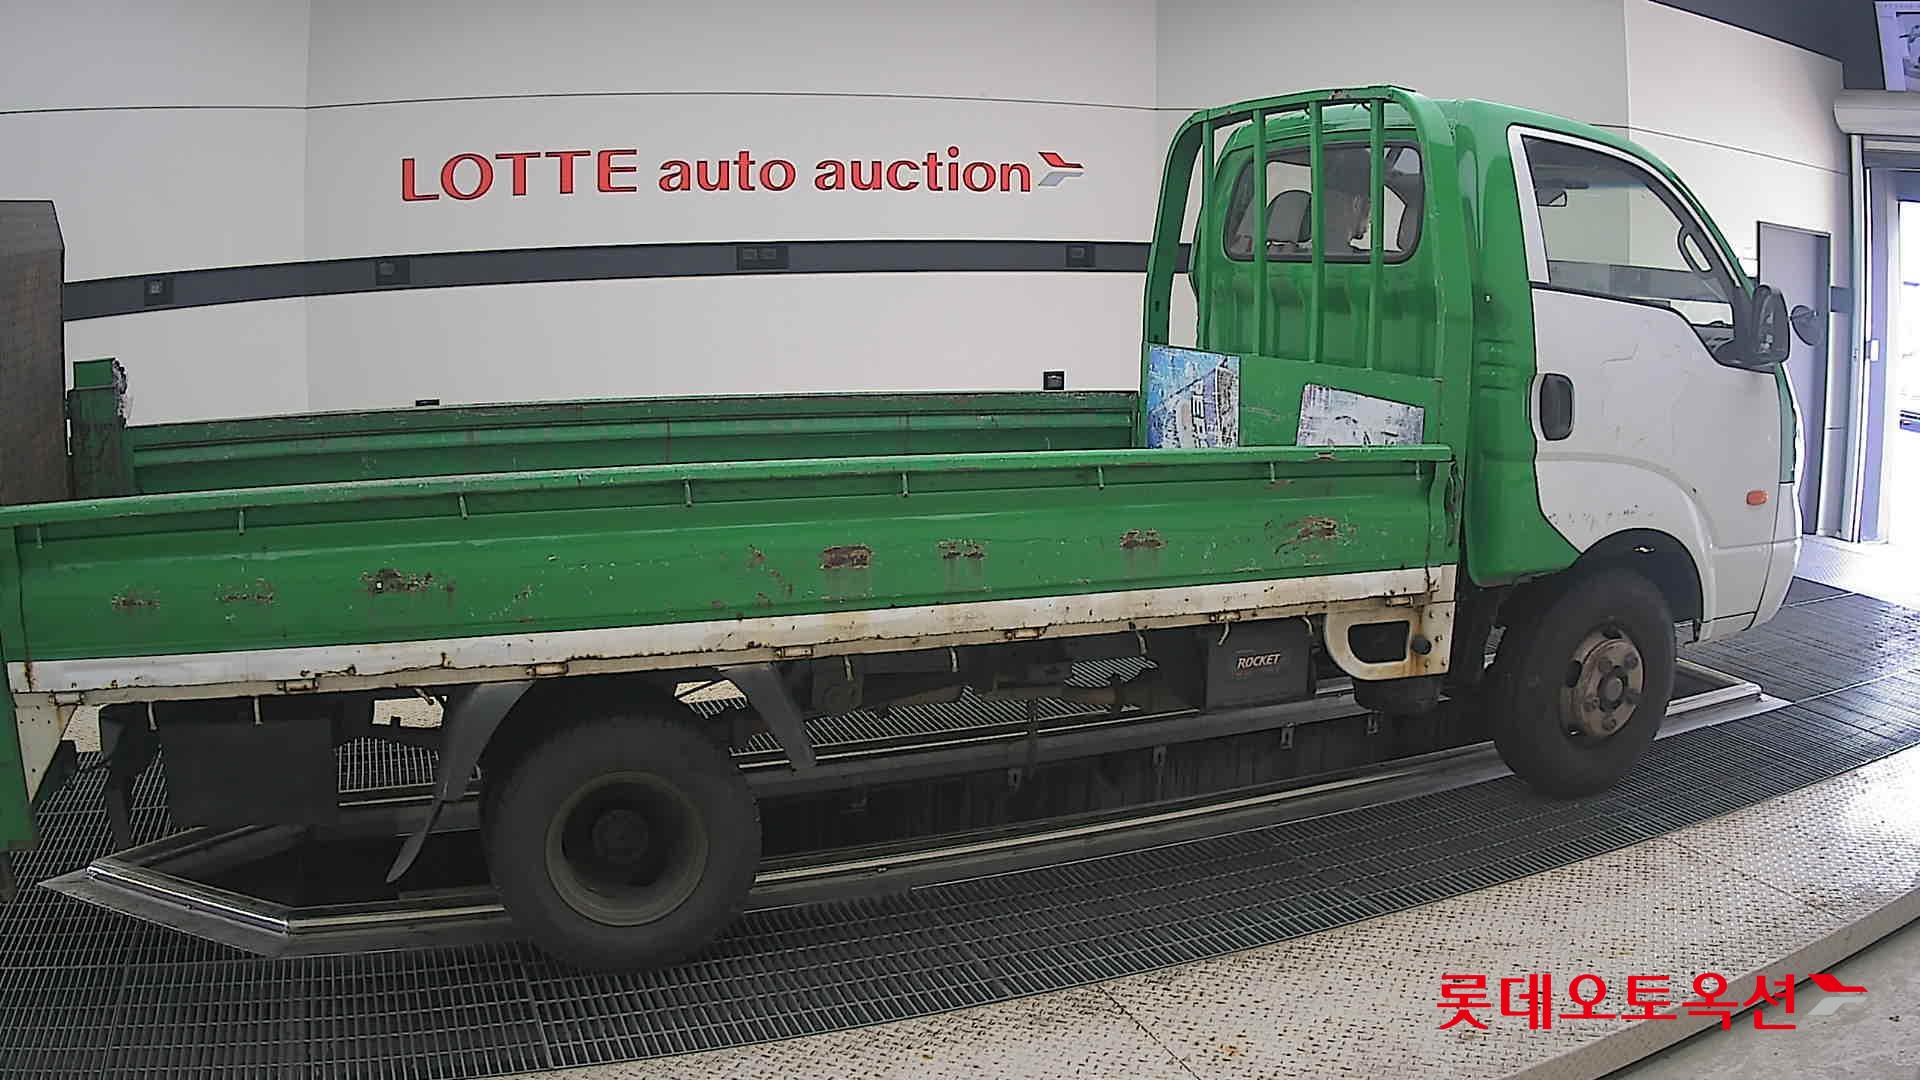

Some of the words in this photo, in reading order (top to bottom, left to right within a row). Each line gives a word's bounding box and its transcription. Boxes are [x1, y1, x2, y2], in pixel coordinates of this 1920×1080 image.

[402, 148, 637, 202] LOTTE
[658, 150, 796, 192] auto
[814, 145, 1032, 193] auction
[1236, 653, 1281, 669] ROCKET
